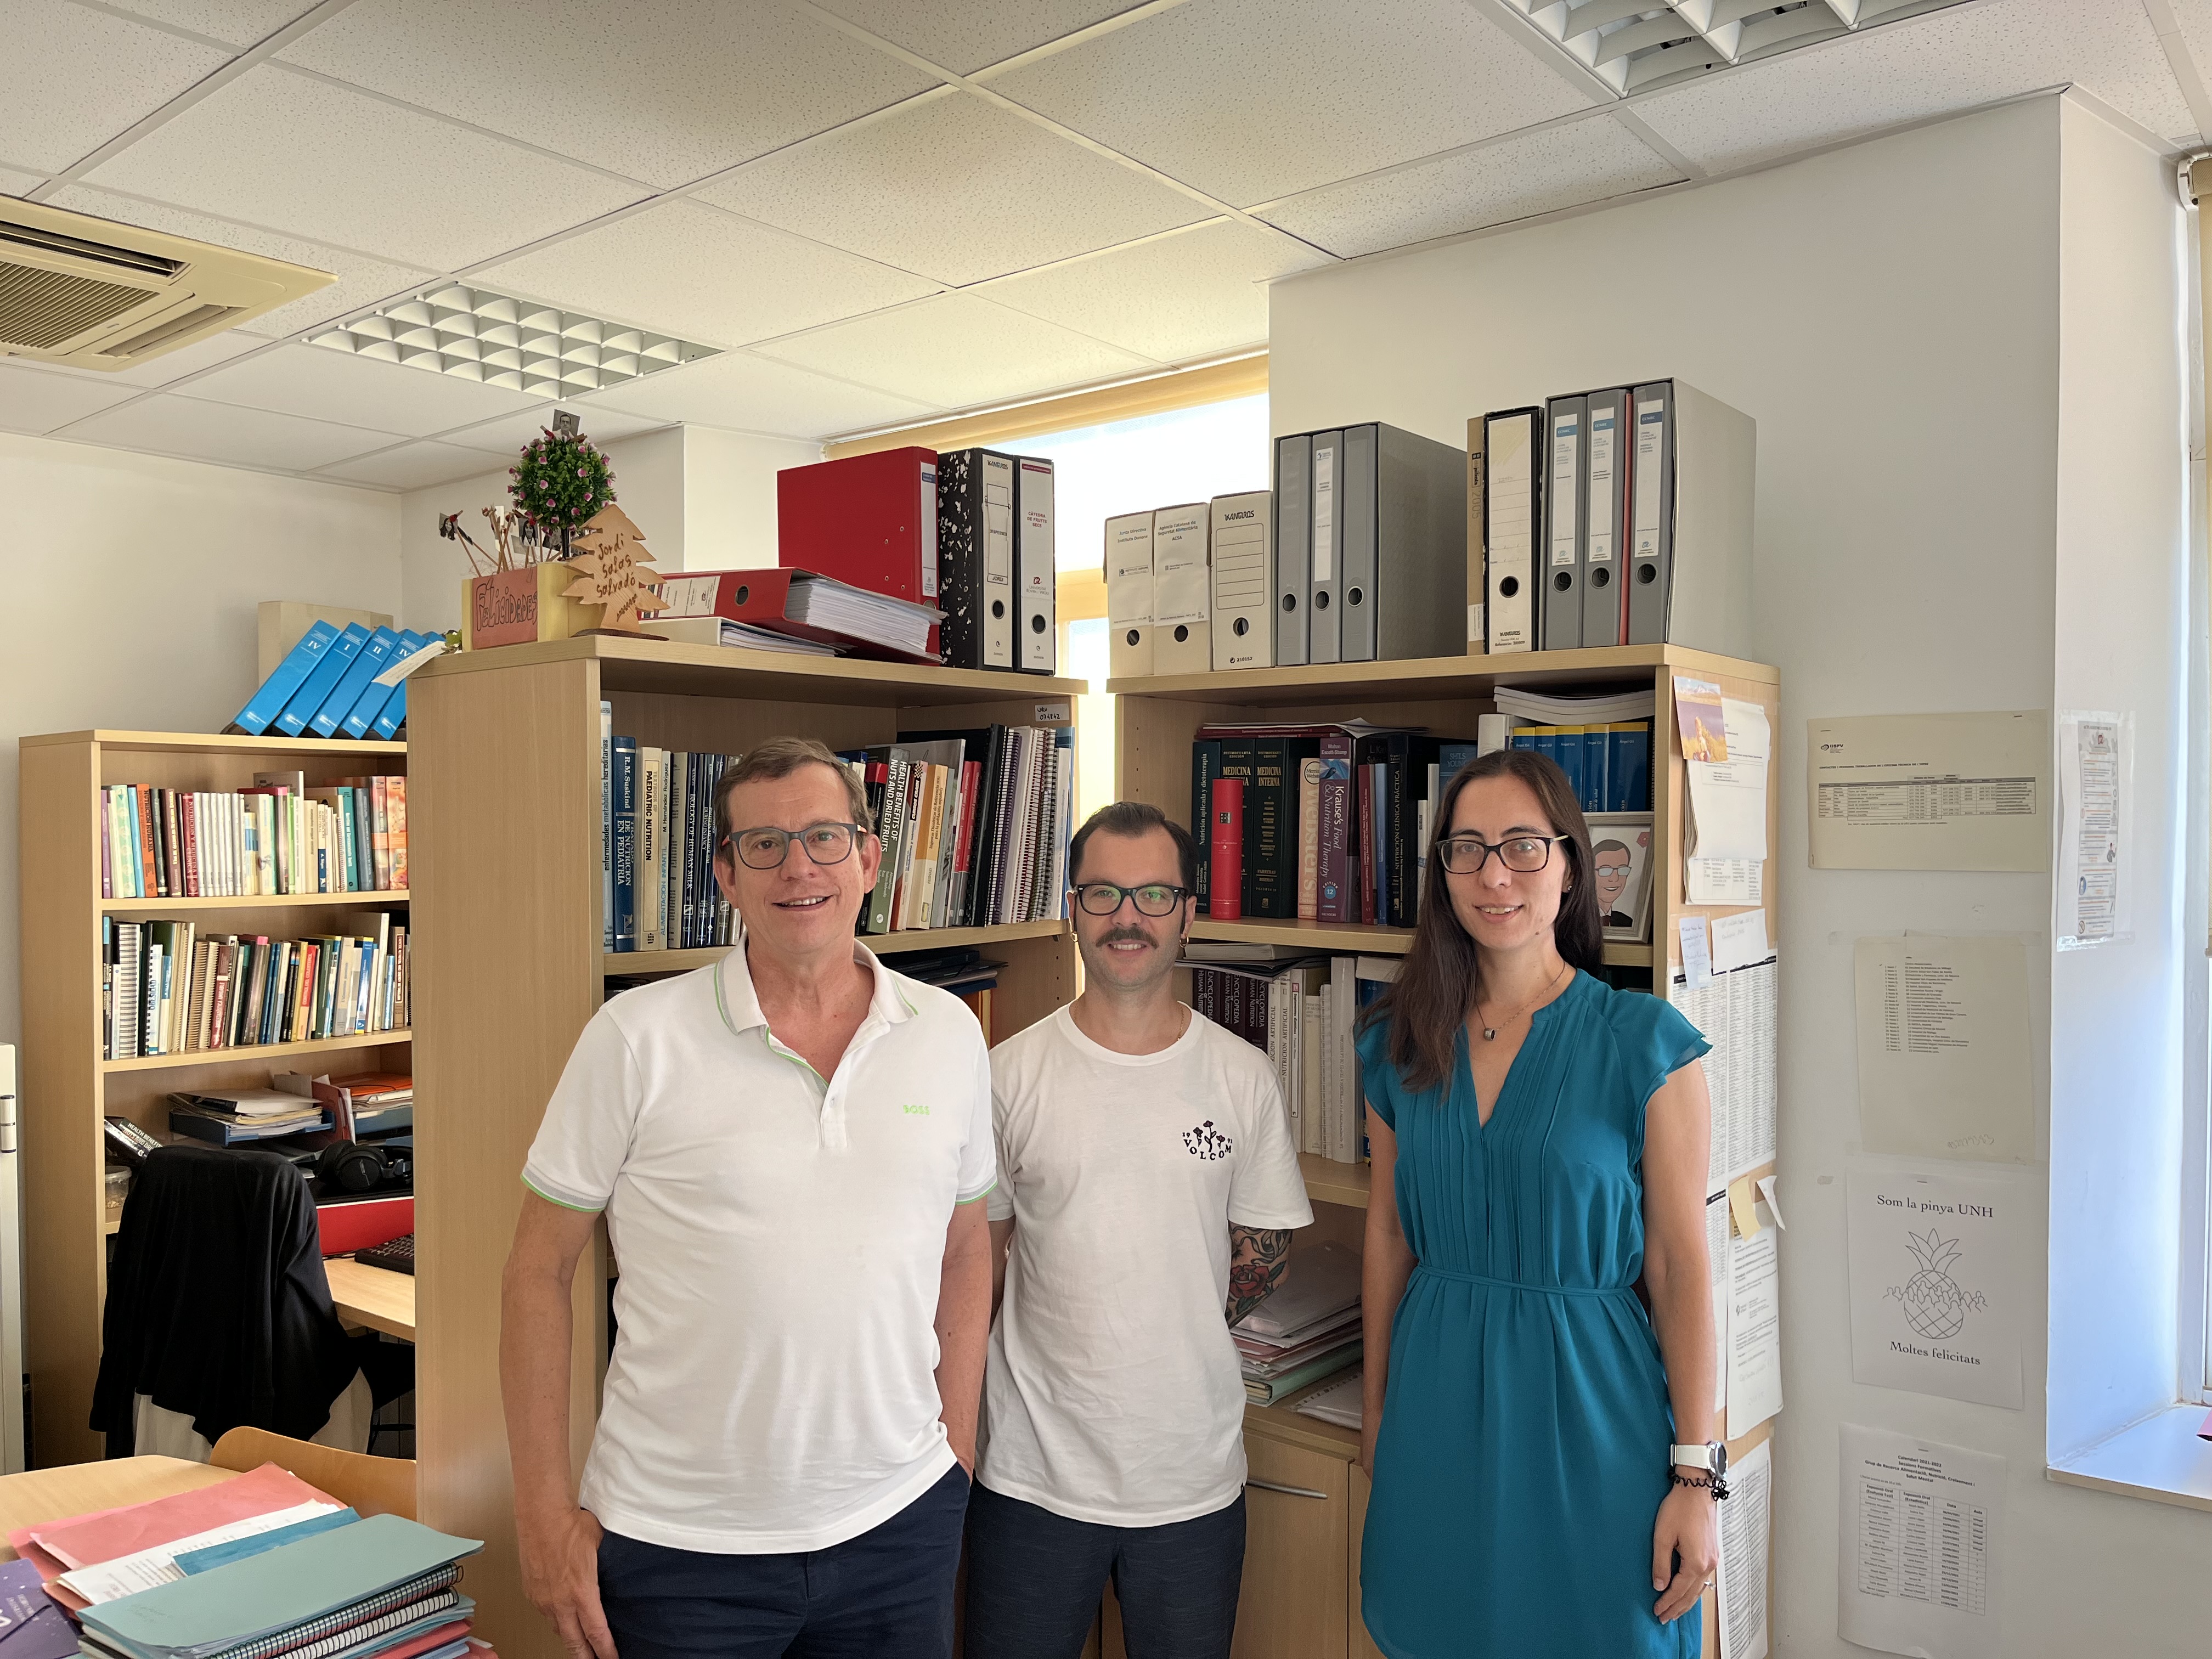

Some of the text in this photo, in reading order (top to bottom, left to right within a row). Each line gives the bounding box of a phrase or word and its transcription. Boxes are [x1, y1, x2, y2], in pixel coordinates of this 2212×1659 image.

[1224, 510, 1255, 521] KANGUROS
[308, 640, 321, 650] IV
[373, 646, 382, 655] II
[399, 647, 411, 657] IV
[1223, 766, 1251, 776] MEDICINA
[1257, 766, 1282, 776] MEDICINA
[1258, 777, 1280, 786] INTERNA
[882, 759, 898, 852] NUTS AND DRIED FRUITS
[891, 761, 907, 841] HEALTH BENEFITS OF
[653, 802, 658, 812] OF
[1323, 794, 1333, 838] Nutrition
[1333, 786, 1344, 849] Krause's Food
[617, 820, 624, 833] EN
[624, 820, 631, 831] DE
[1320, 840, 1331, 878] Therapy
[903, 1105, 930, 1115] BOSS
[127, 1122, 163, 1147] HEALTH BENEFIT
[143, 1142, 154, 1152] DRI
[1183, 1139, 1232, 1160] VOLCOM
[1877, 1194, 1993, 1218] Som la pinya UNH
[1890, 1341, 1981, 1365] Moltes felicitats
